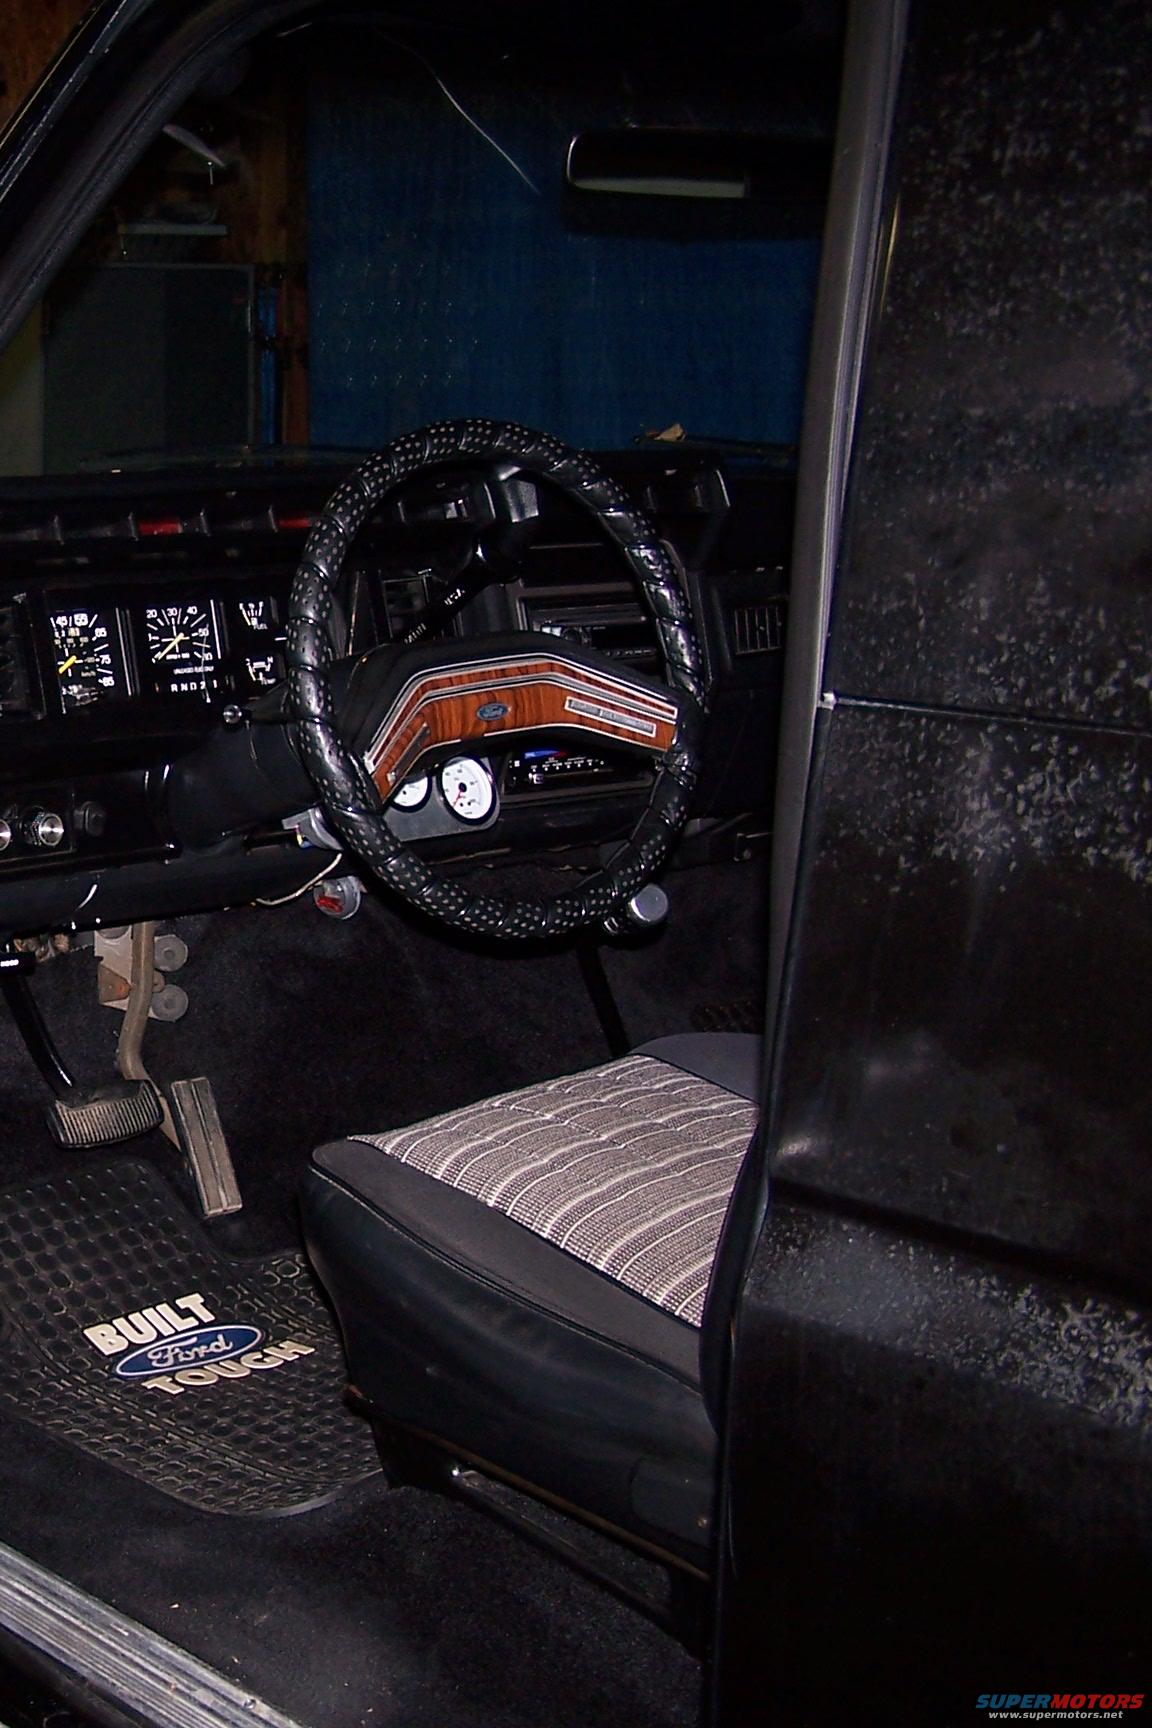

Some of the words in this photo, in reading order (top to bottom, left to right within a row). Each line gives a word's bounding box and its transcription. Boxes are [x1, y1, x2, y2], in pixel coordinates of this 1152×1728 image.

[146, 609, 157, 618] 20
[167, 607, 177, 616] 30
[187, 606, 197, 614] 40
[190, 682, 197, 691] D
[83, 1292, 216, 1356] BUILT
[141, 1340, 316, 1395] TOUGH
[147, 1333, 234, 1368] Ford
